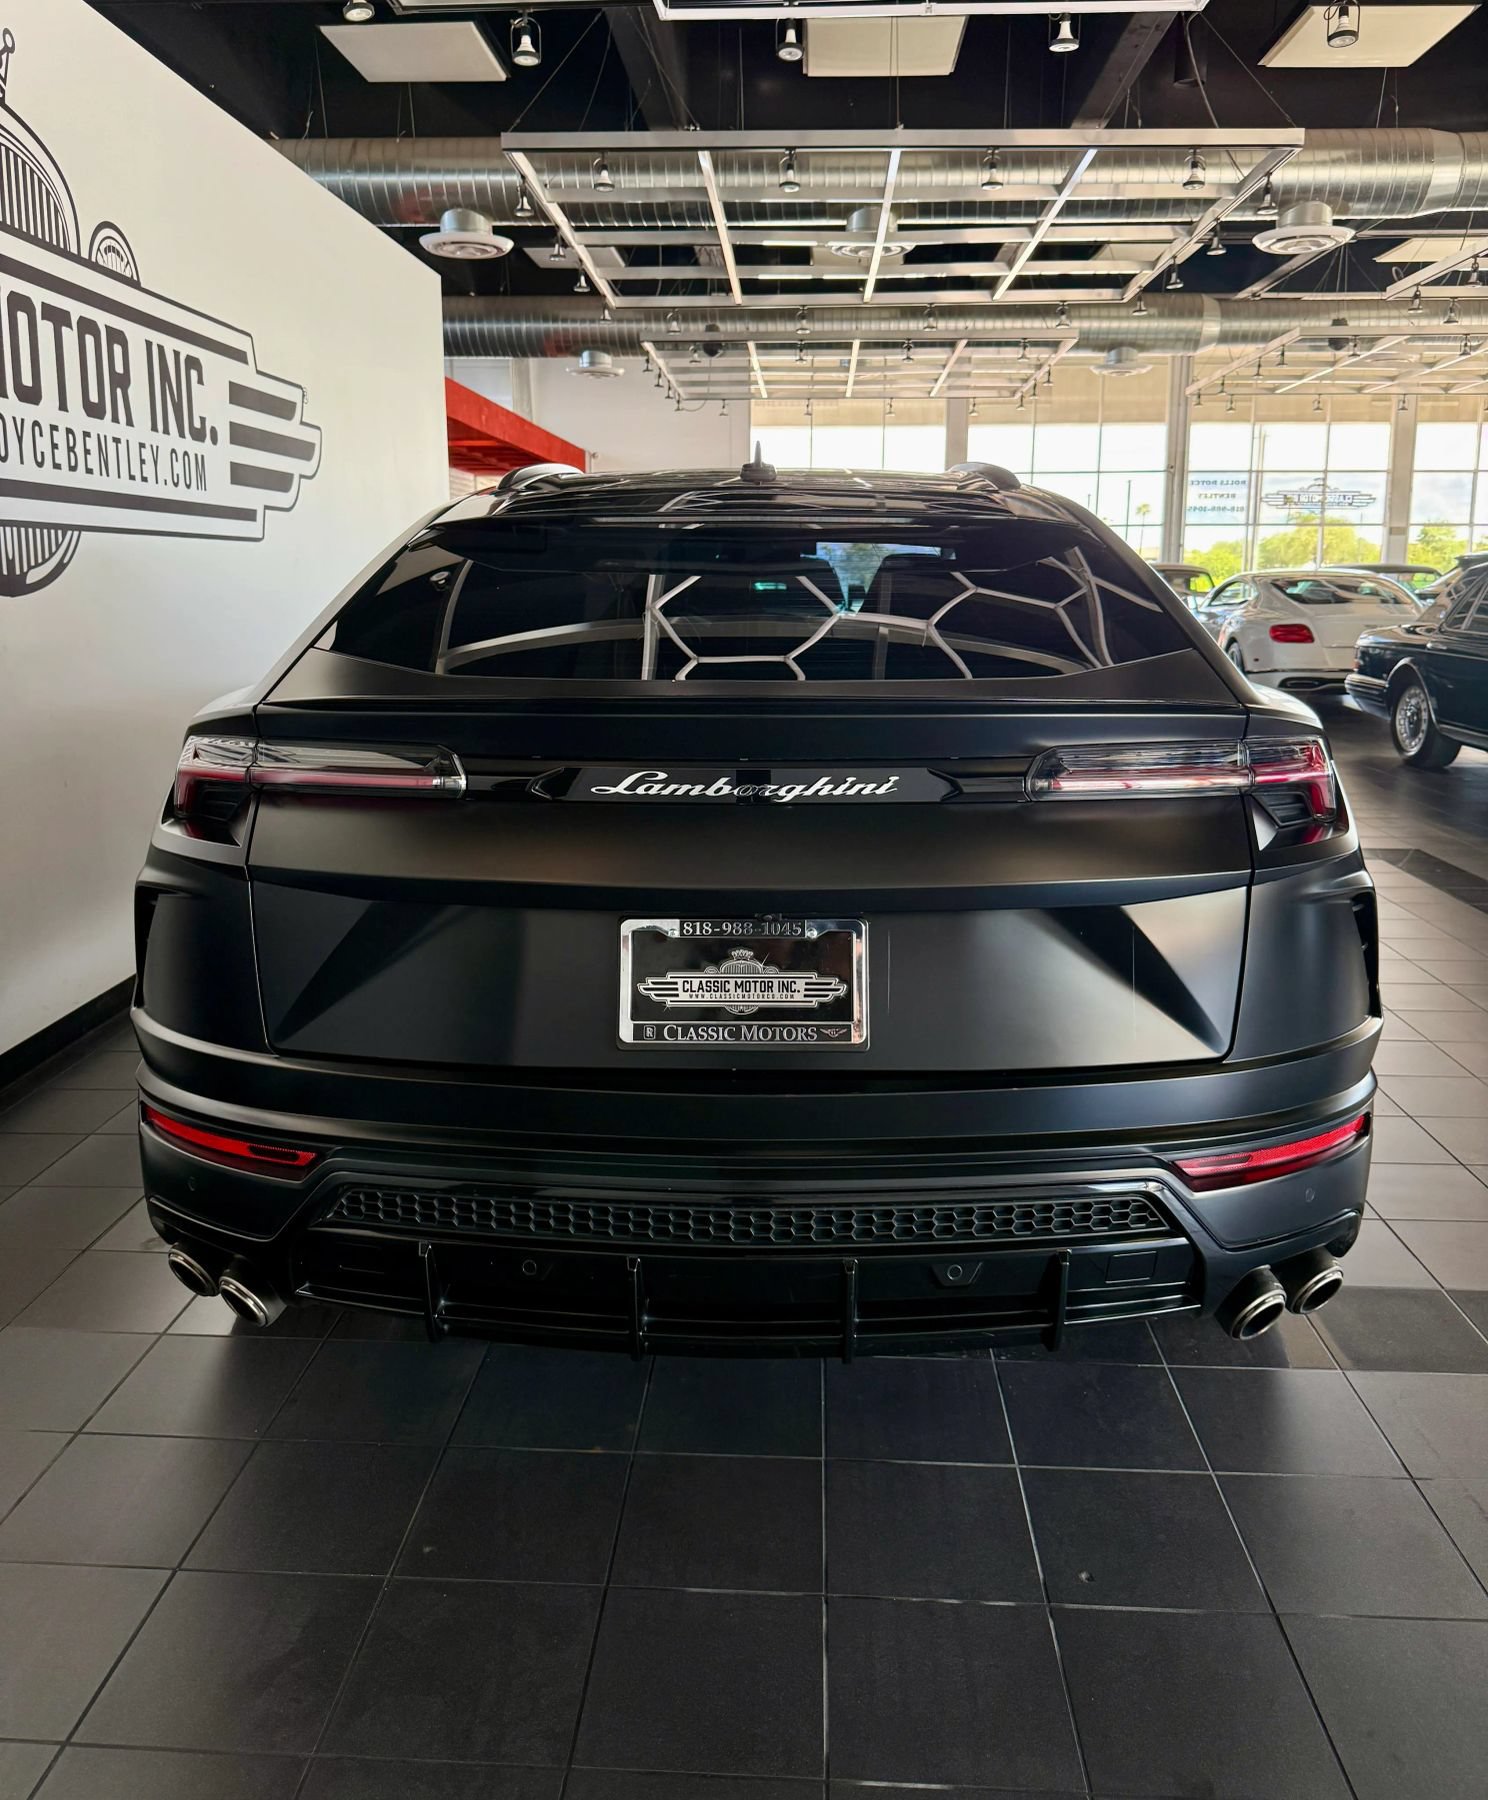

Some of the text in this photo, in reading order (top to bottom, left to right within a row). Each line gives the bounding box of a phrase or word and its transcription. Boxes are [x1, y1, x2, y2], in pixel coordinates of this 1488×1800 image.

[0, 286, 219, 446] OTOR INC.
[590, 770, 900, 802] Lamborghini
[682, 921, 802, 936] 818-988-1045
[682, 980, 800, 993] CLASSIC MOTOR INC.
[663, 1024, 736, 1041] CLASSIC
[740, 1024, 818, 1041] MOTORS
